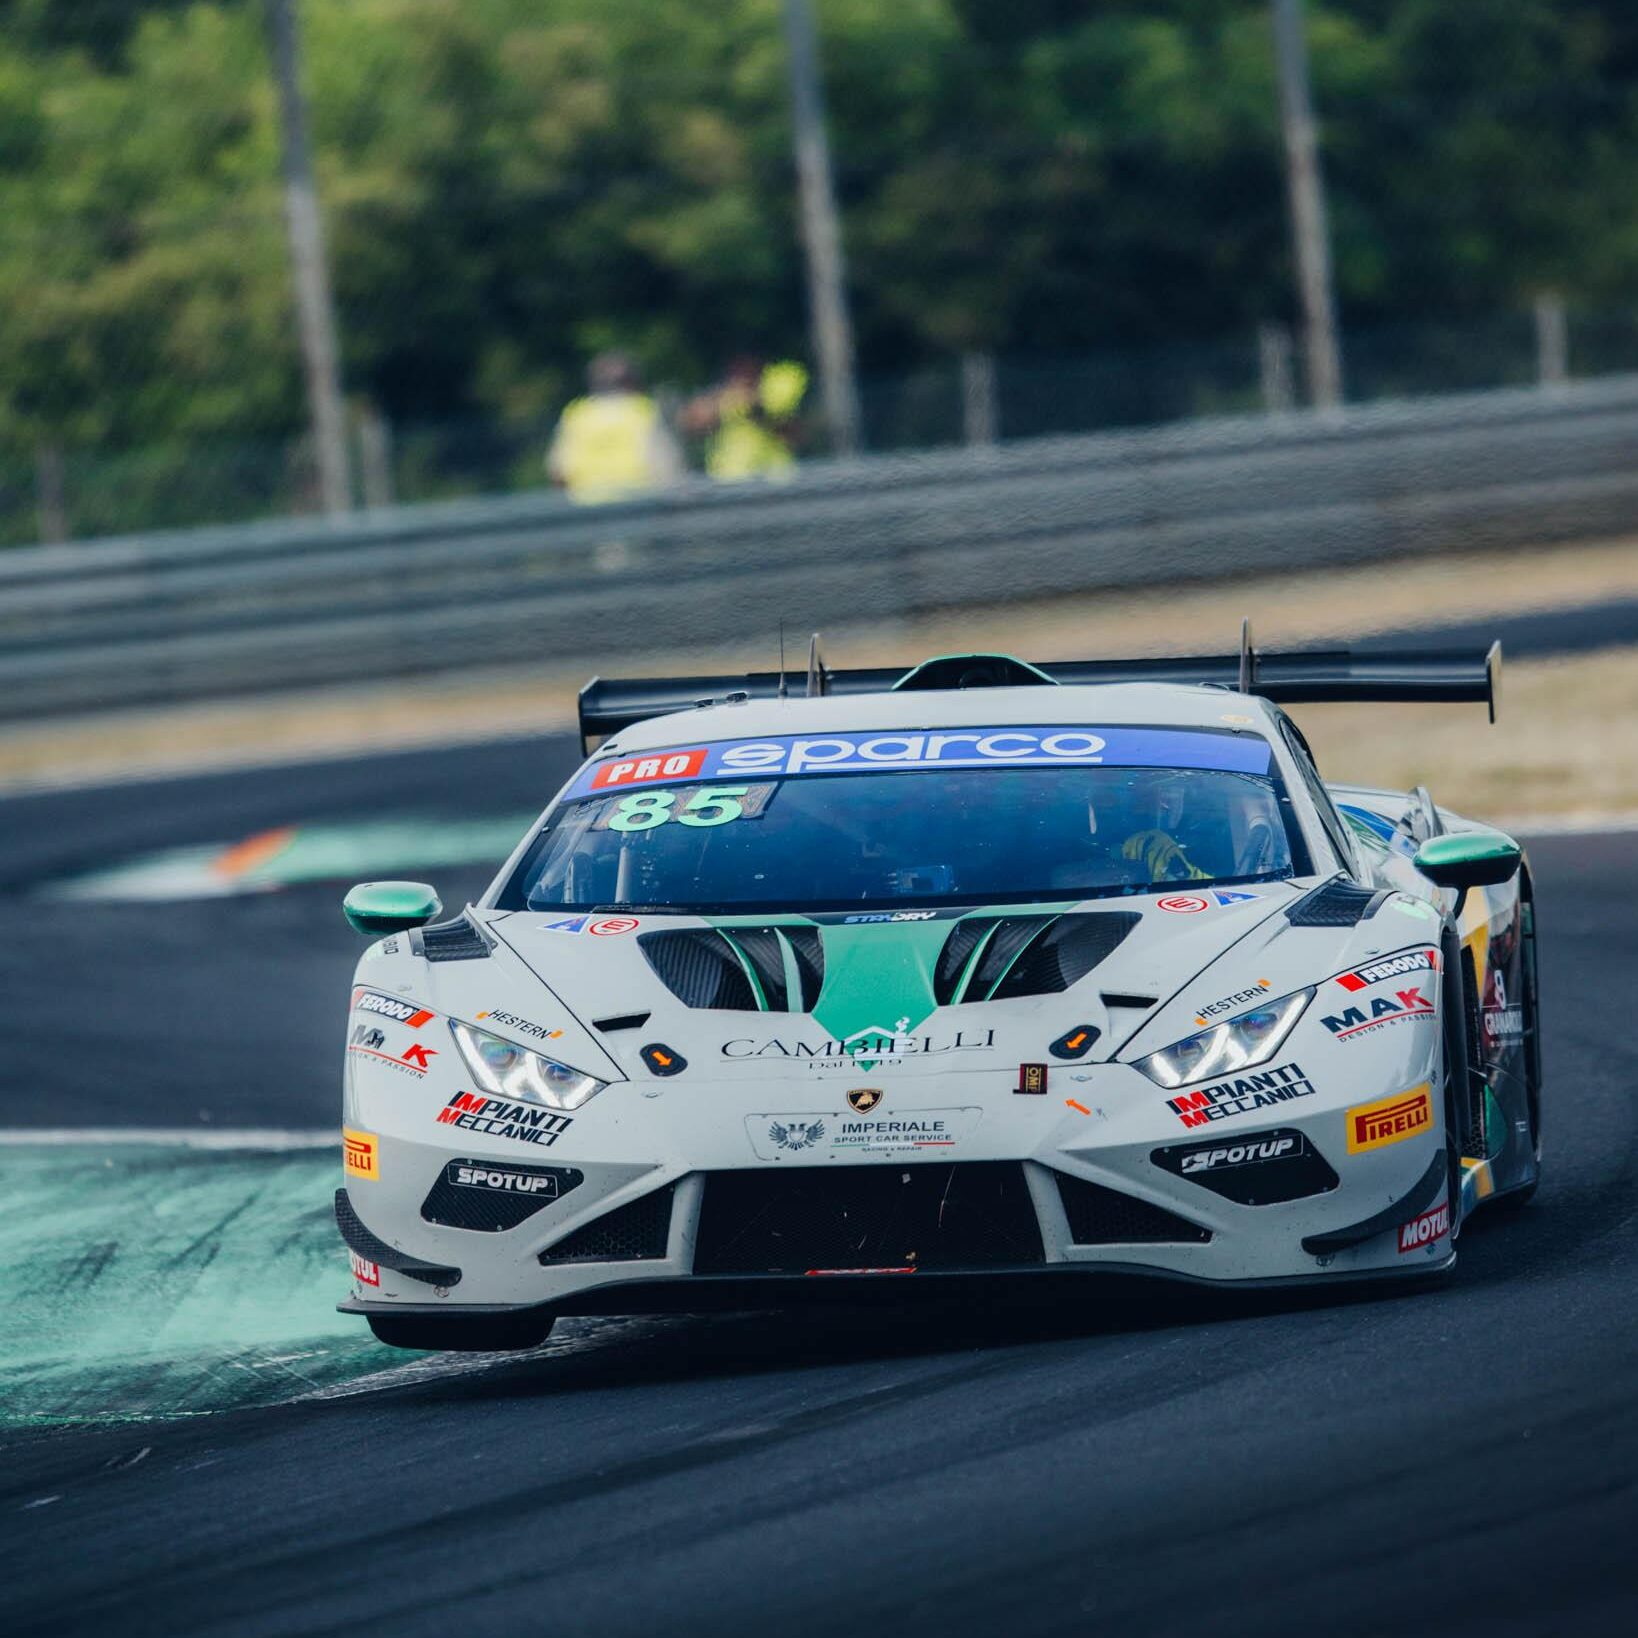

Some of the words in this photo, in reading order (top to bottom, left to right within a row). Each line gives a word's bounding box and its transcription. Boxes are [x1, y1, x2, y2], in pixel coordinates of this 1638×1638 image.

[607, 755, 691, 784] PRO
[720, 732, 1106, 775] sparco
[607, 786, 749, 832] 85
[1359, 953, 1430, 983] FERODO
[356, 993, 414, 1020] FERODO
[1195, 984, 1270, 1019] HESTERN
[1320, 987, 1433, 1033] MAK
[487, 1009, 553, 1040] HESTERN
[721, 1029, 995, 1058] CAMBIELLI
[350, 1024, 440, 1068] MK
[1165, 1062, 1308, 1115] IMPIANTI
[1179, 1079, 1316, 1129] MECCANICI
[436, 1107, 560, 1147] MECCANICI
[447, 1090, 574, 1133] IMPIANTI
[842, 1121, 945, 1134] IMPERIALE
[1355, 1094, 1428, 1144] PIRELLI
[903, 1134, 952, 1142] SERVICE
[456, 1167, 549, 1192] SPOTUP
